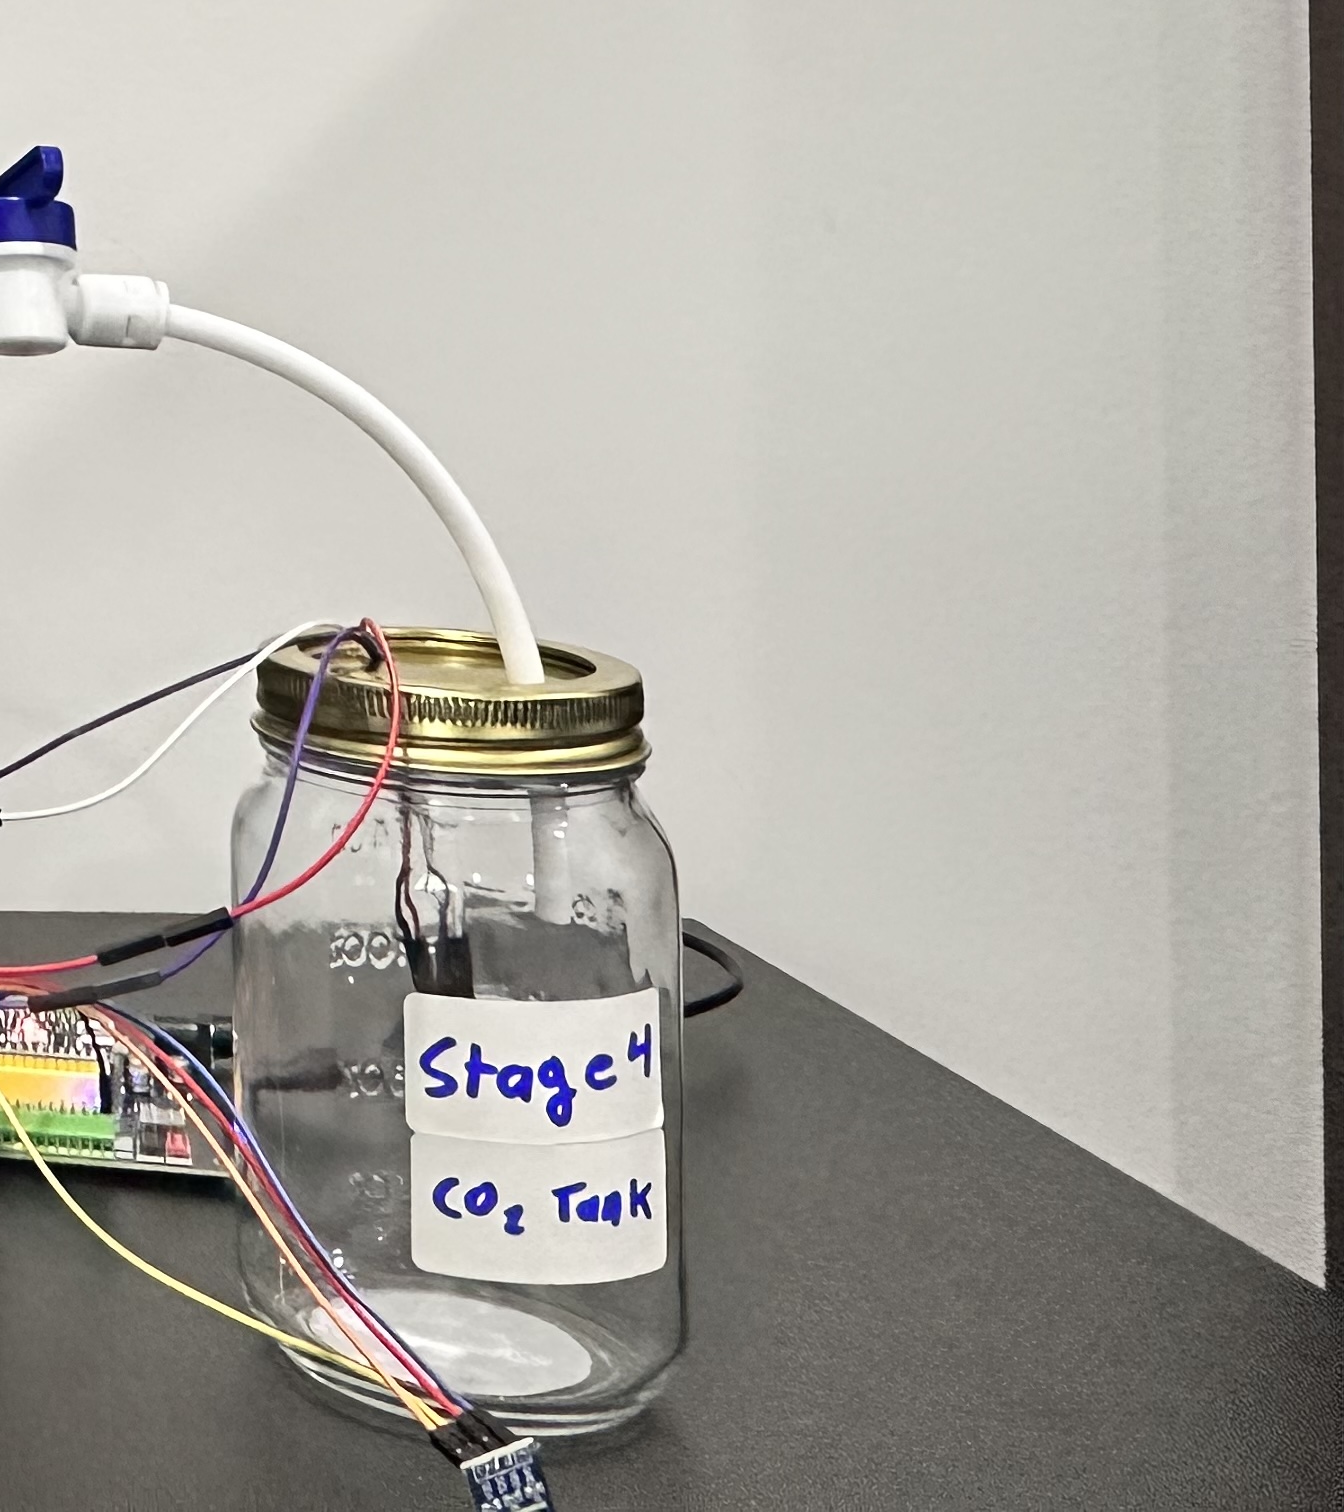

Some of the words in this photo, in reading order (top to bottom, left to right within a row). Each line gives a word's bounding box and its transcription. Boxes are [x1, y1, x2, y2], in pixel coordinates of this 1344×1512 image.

[418, 1035, 618, 1128] Stage
[627, 1023, 652, 1078] 4
[551, 1177, 653, 1228] Tank
